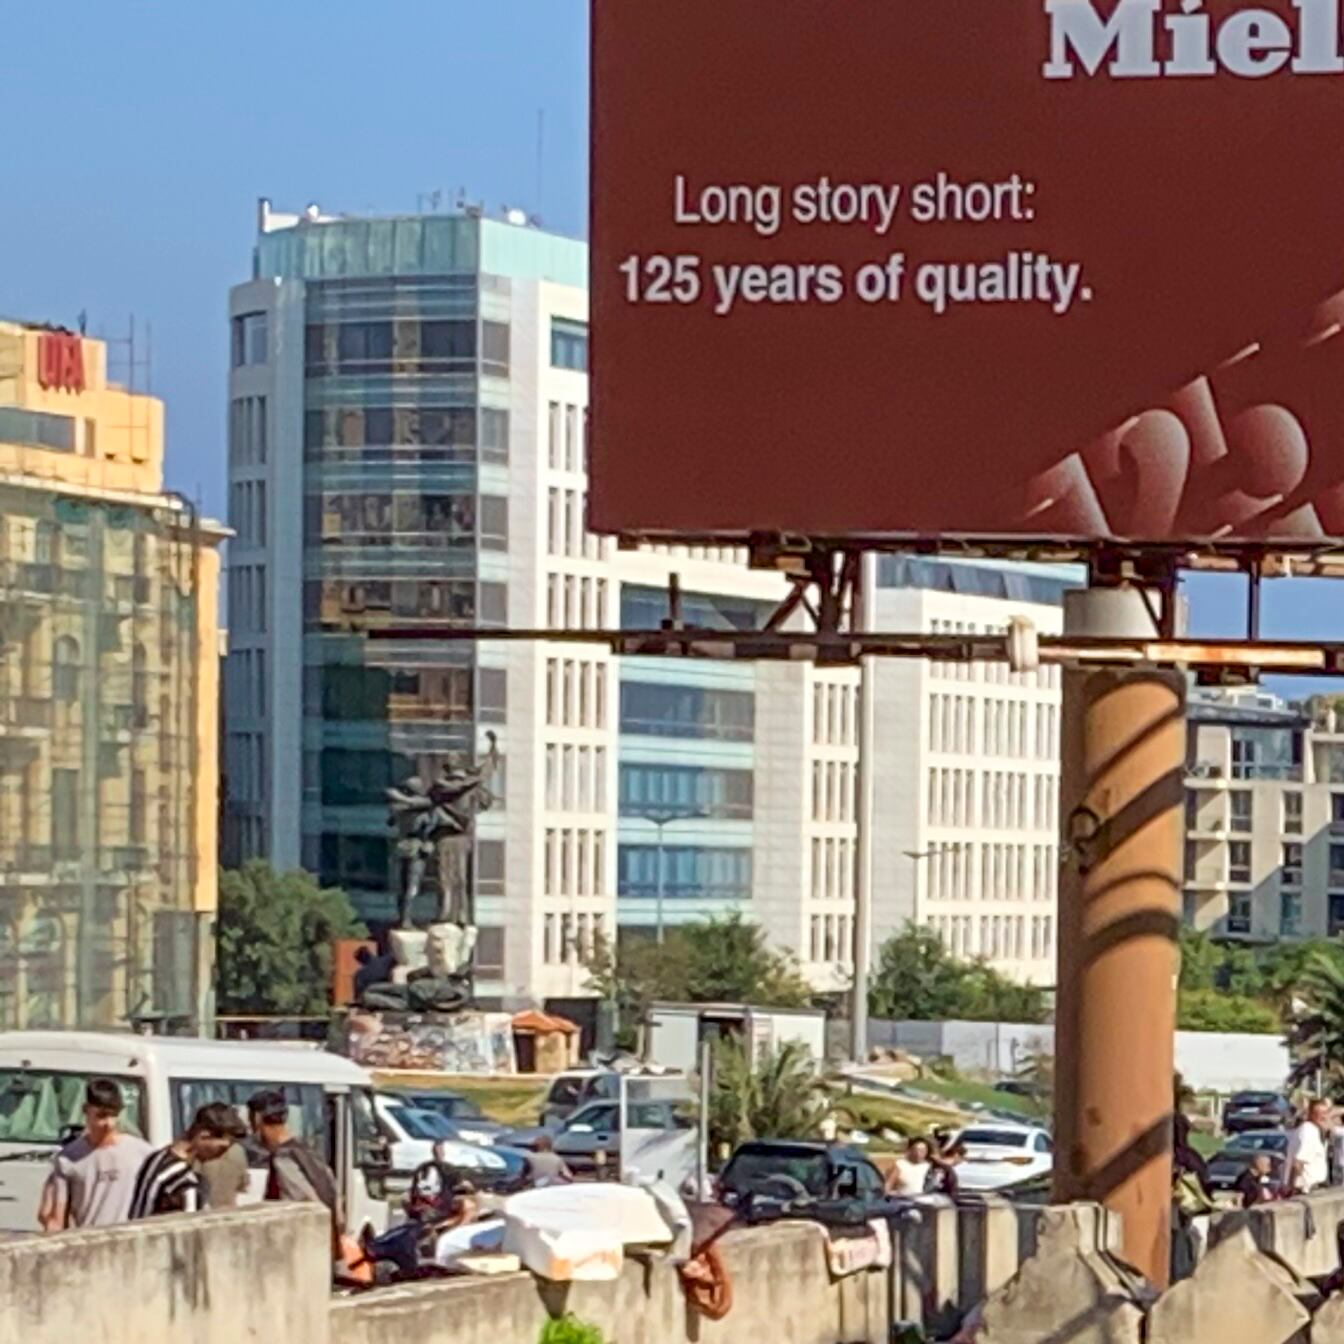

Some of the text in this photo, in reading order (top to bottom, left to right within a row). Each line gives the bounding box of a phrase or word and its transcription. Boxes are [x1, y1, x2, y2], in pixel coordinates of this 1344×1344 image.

[675, 171, 1035, 235] Long story short:
[618, 251, 1092, 315] 125 years of quality.
